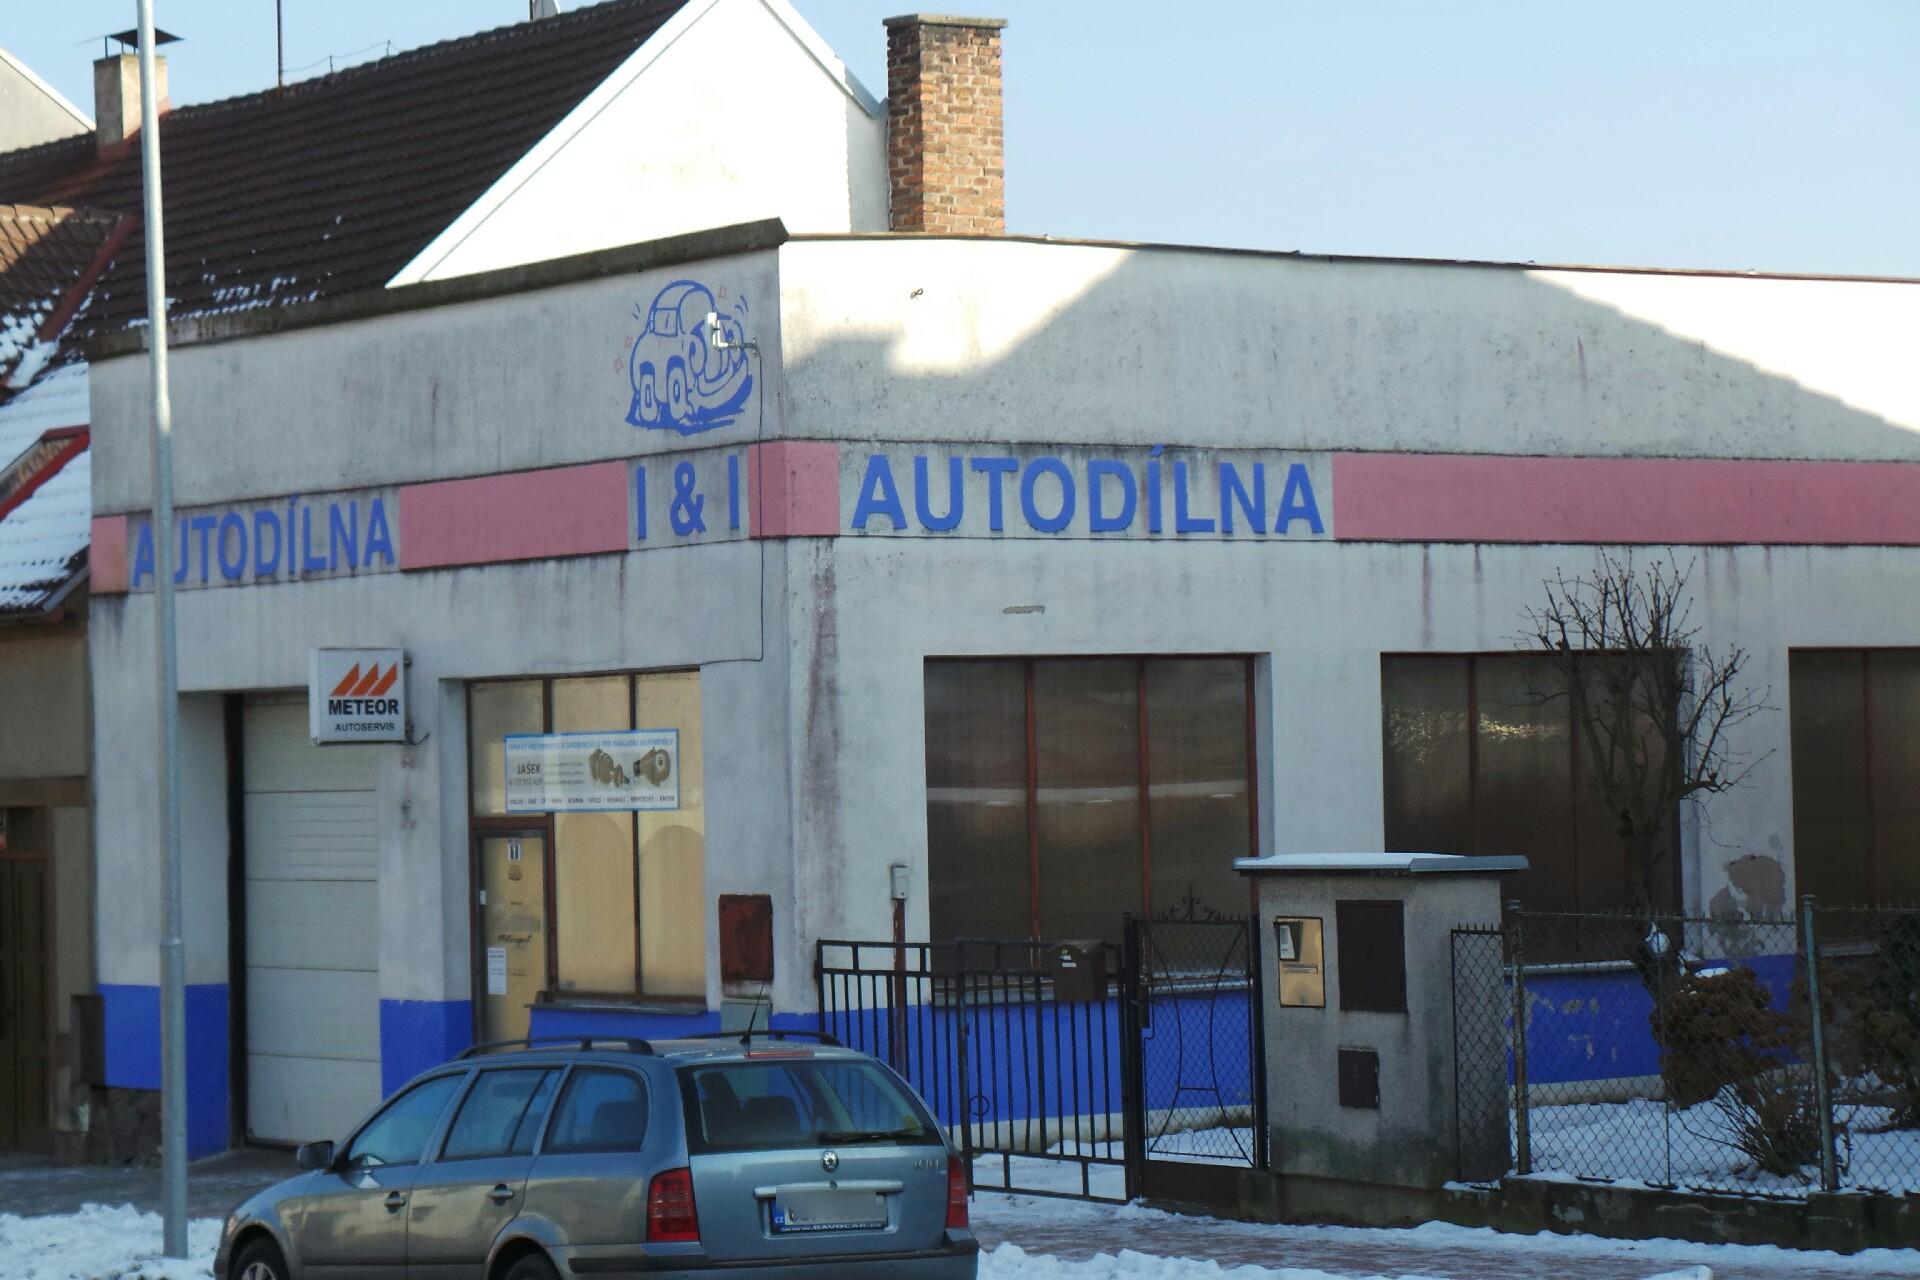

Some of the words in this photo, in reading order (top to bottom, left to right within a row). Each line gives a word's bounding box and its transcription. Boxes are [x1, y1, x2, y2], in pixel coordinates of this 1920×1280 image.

[636, 465, 647, 540] I
[670, 461, 707, 537] &
[728, 454, 740, 530] I
[851, 443, 1325, 534] AUTODÍLNA
[327, 698, 400, 716] METEOR
[335, 722, 395, 732] AUTOSERVIS
